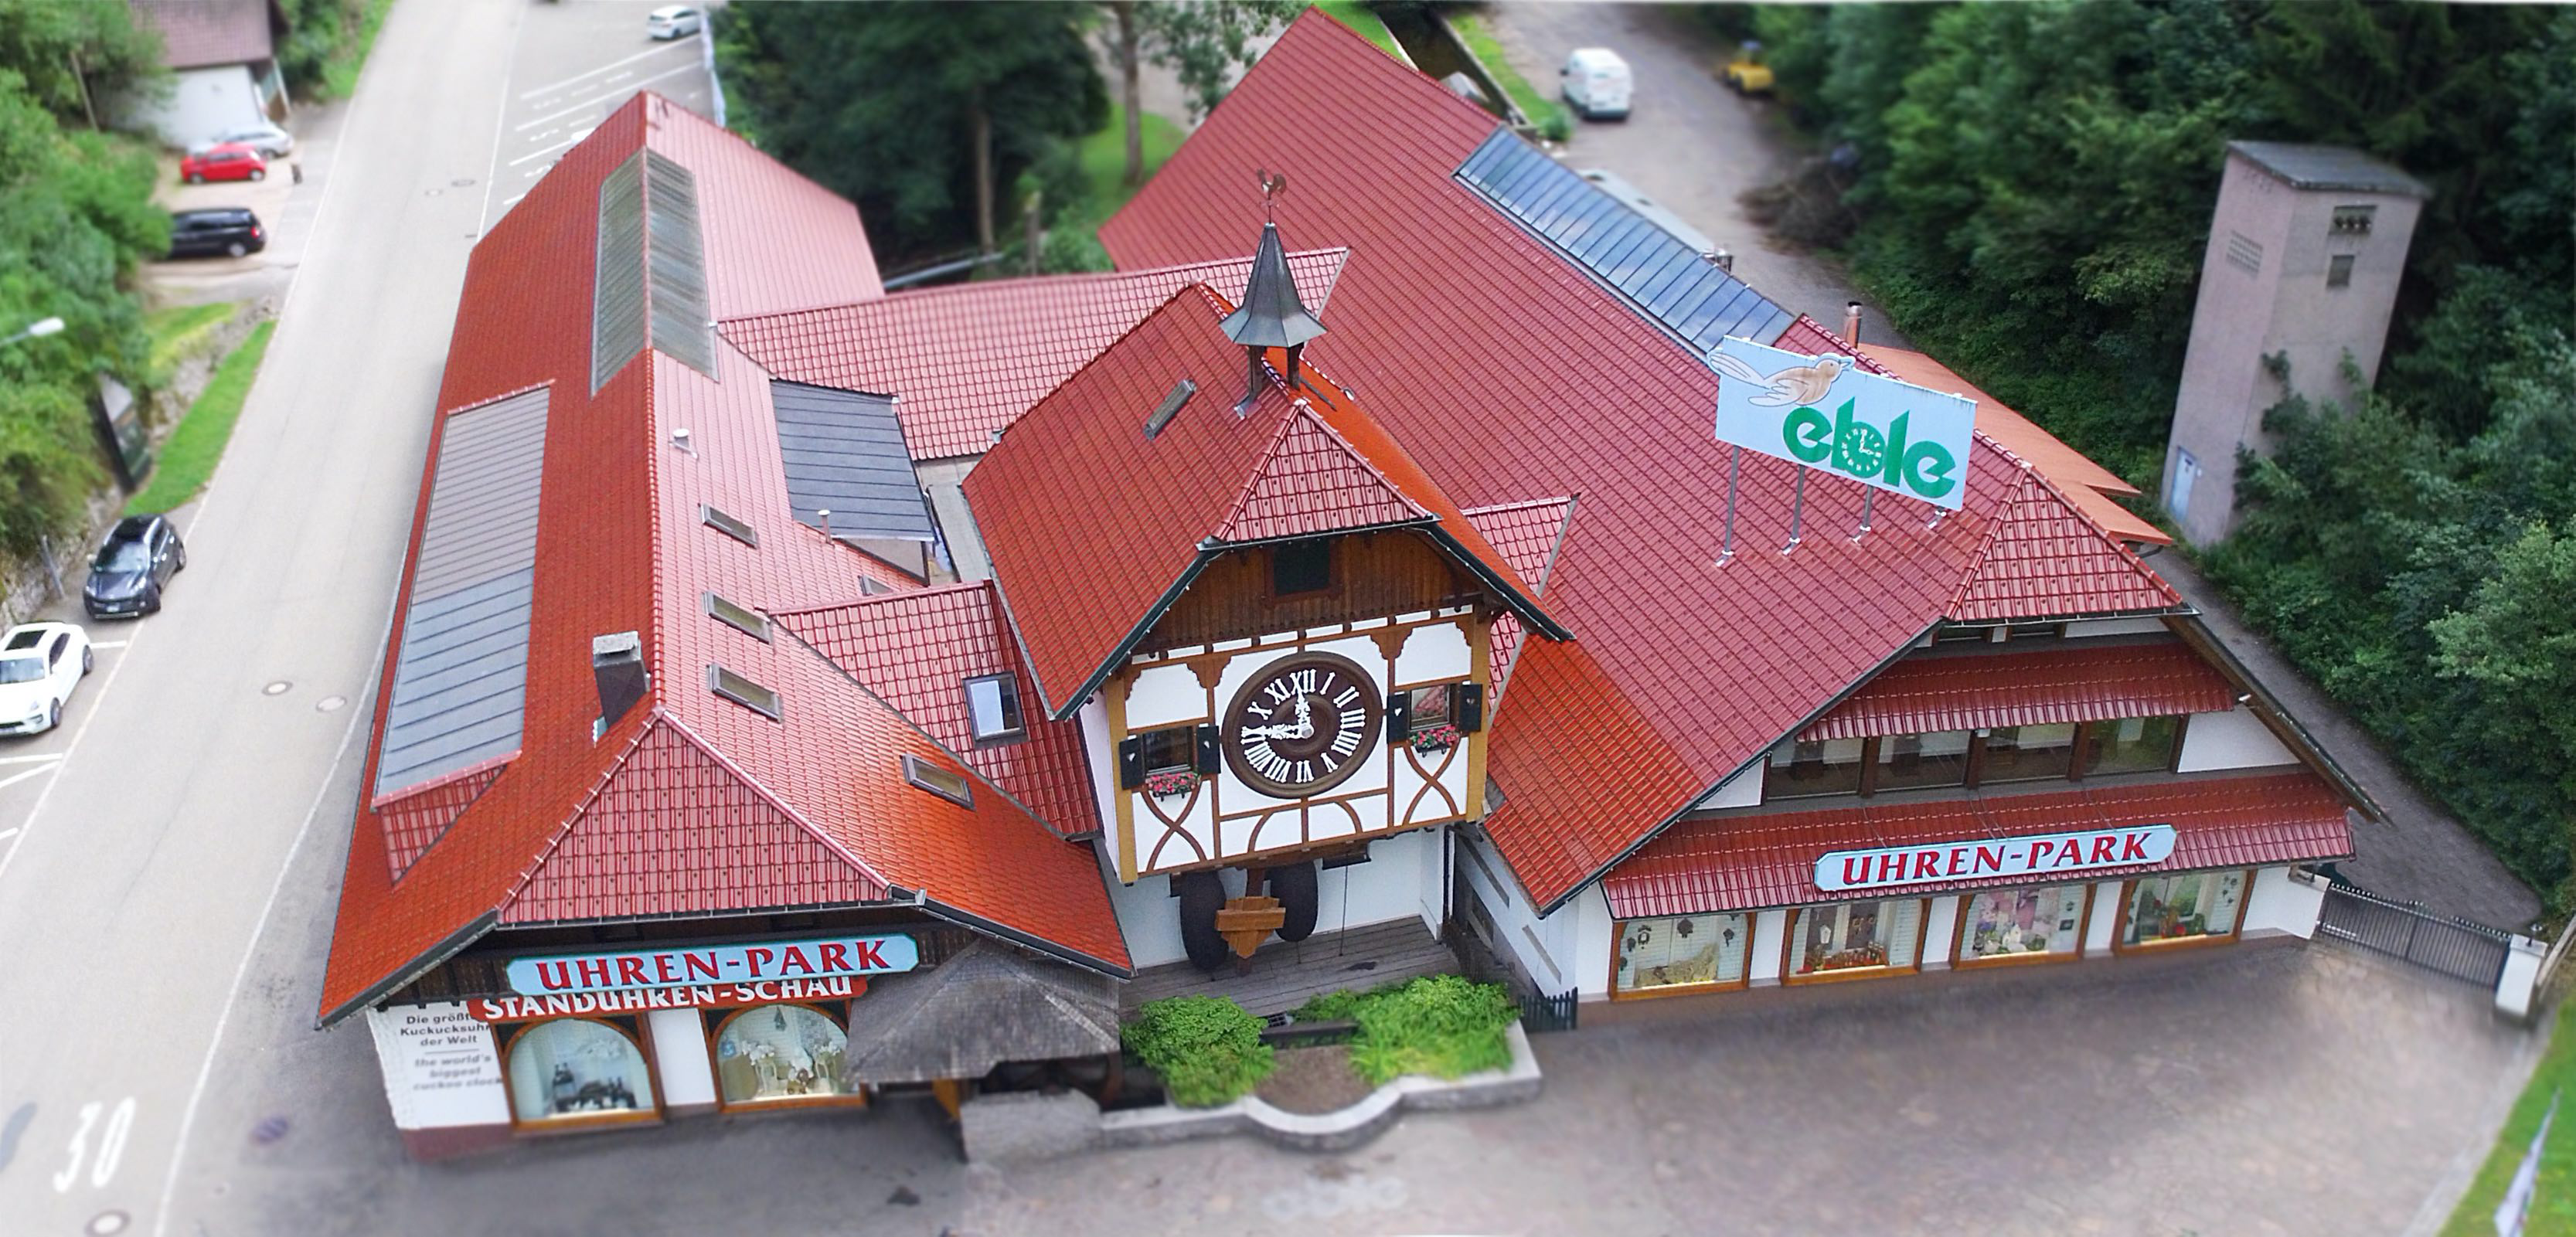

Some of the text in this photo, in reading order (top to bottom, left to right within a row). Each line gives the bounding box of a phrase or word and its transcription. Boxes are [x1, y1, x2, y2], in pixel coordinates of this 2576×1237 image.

[1782, 396, 1957, 499] eble
[1264, 678, 1291, 705] XI
[1288, 668, 1316, 696] XII
[1247, 701, 1273, 720] X
[1332, 685, 1359, 709] II
[1340, 707, 1366, 729] III
[1320, 752, 1339, 773] V
[1842, 832, 2152, 885] UHREN-PARK
[536, 939, 892, 991] UHREN-PARK
[482, 976, 852, 1020] STANDUHREN-SCHAU
[406, 1012, 474, 1025] Die größt
[420, 1035, 478, 1047] der Welt
[53, 1096, 137, 1194] 30
